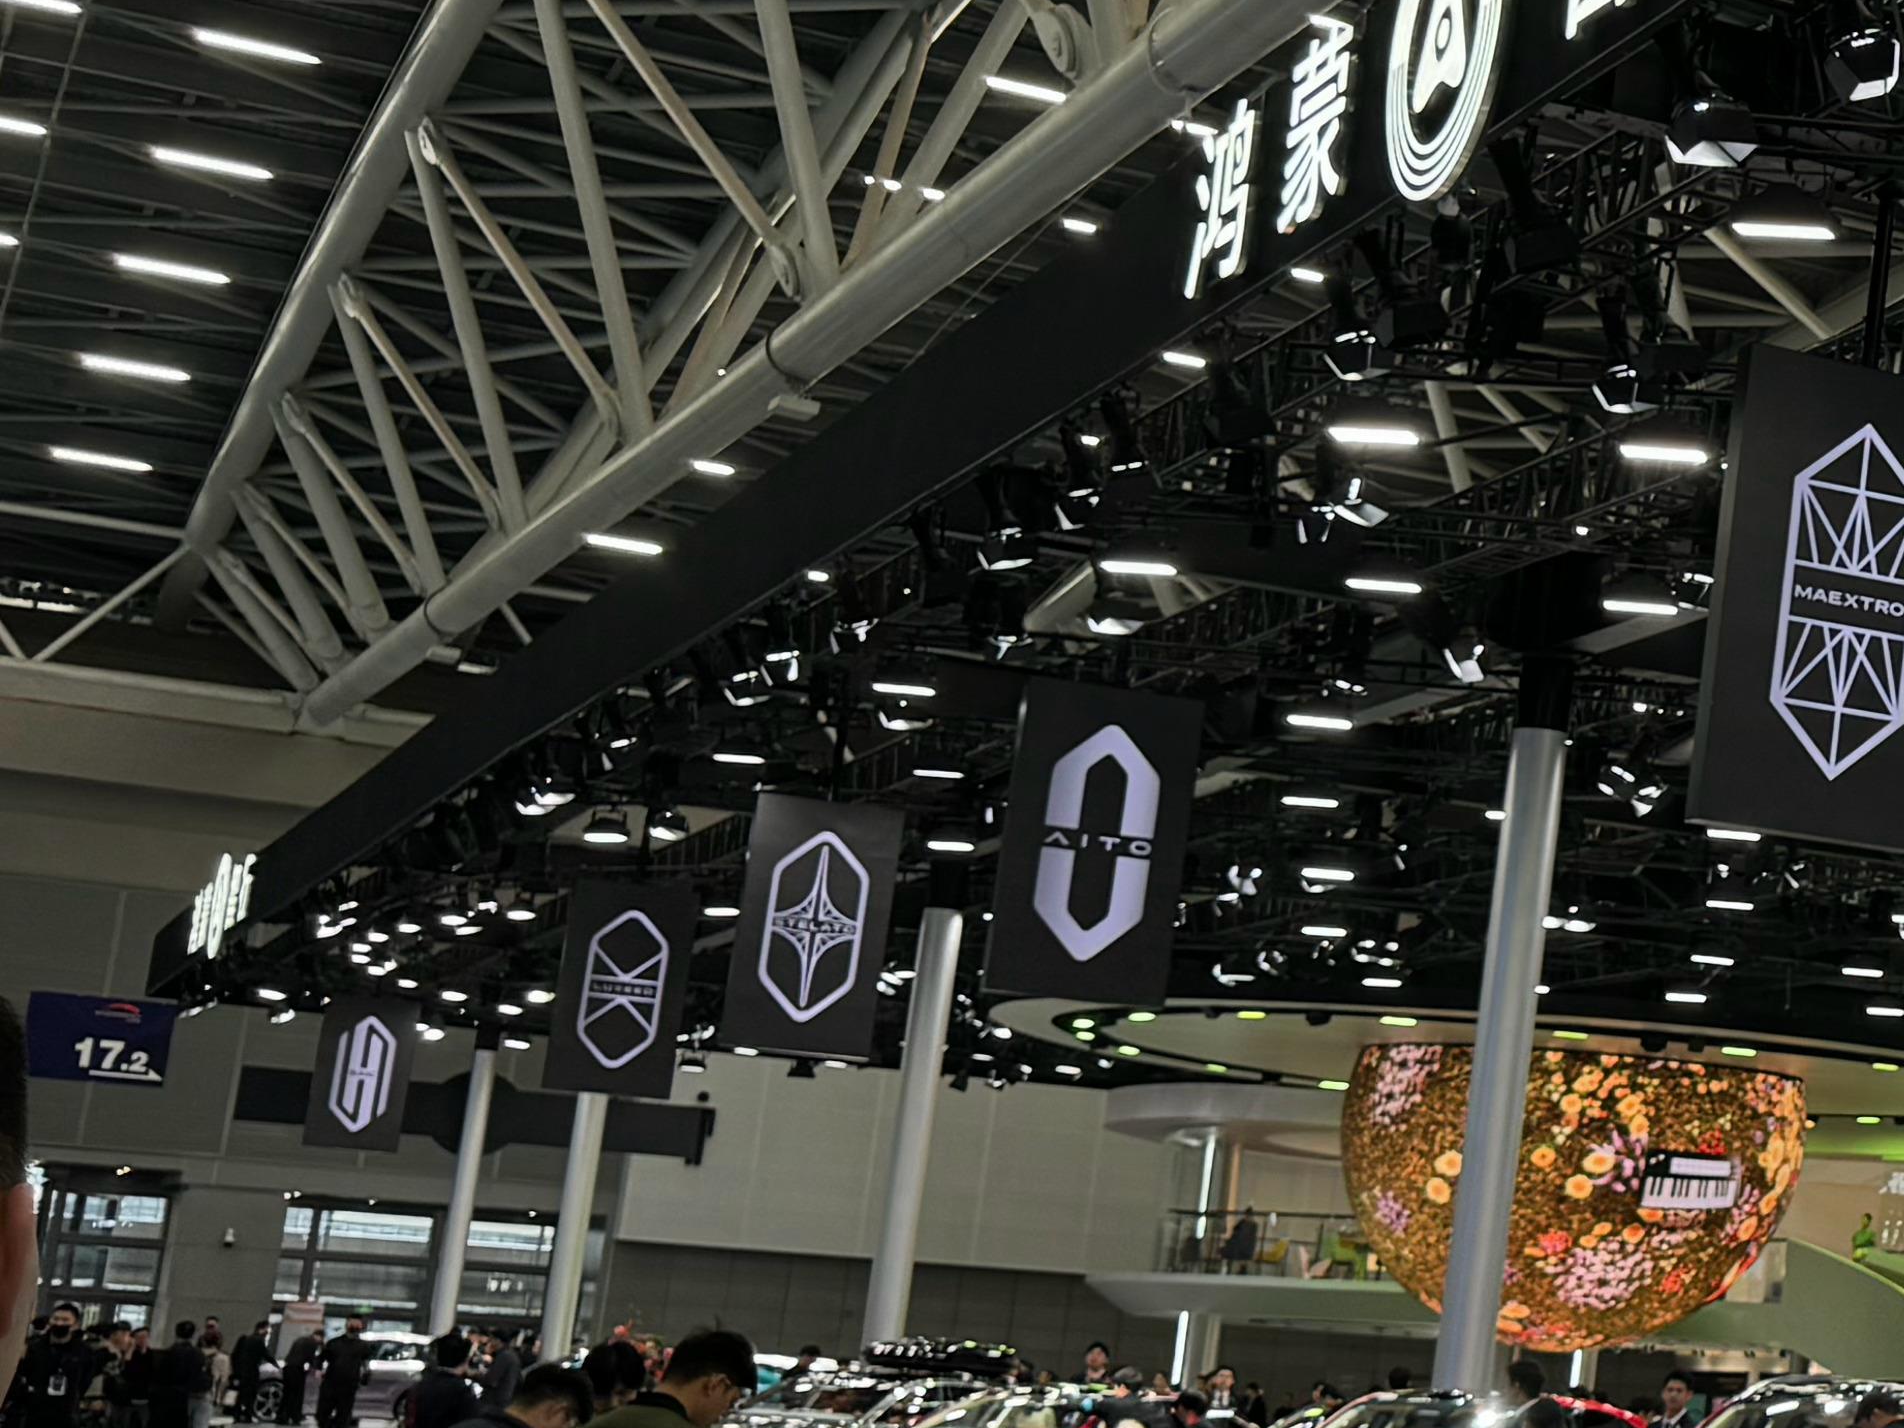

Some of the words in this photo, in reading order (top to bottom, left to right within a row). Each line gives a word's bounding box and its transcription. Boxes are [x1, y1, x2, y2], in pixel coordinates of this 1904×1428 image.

[1184, 25, 1354, 300] 鸿蒙
[1044, 830, 1152, 857] AITO
[74, 1036, 150, 1072] 17.2
